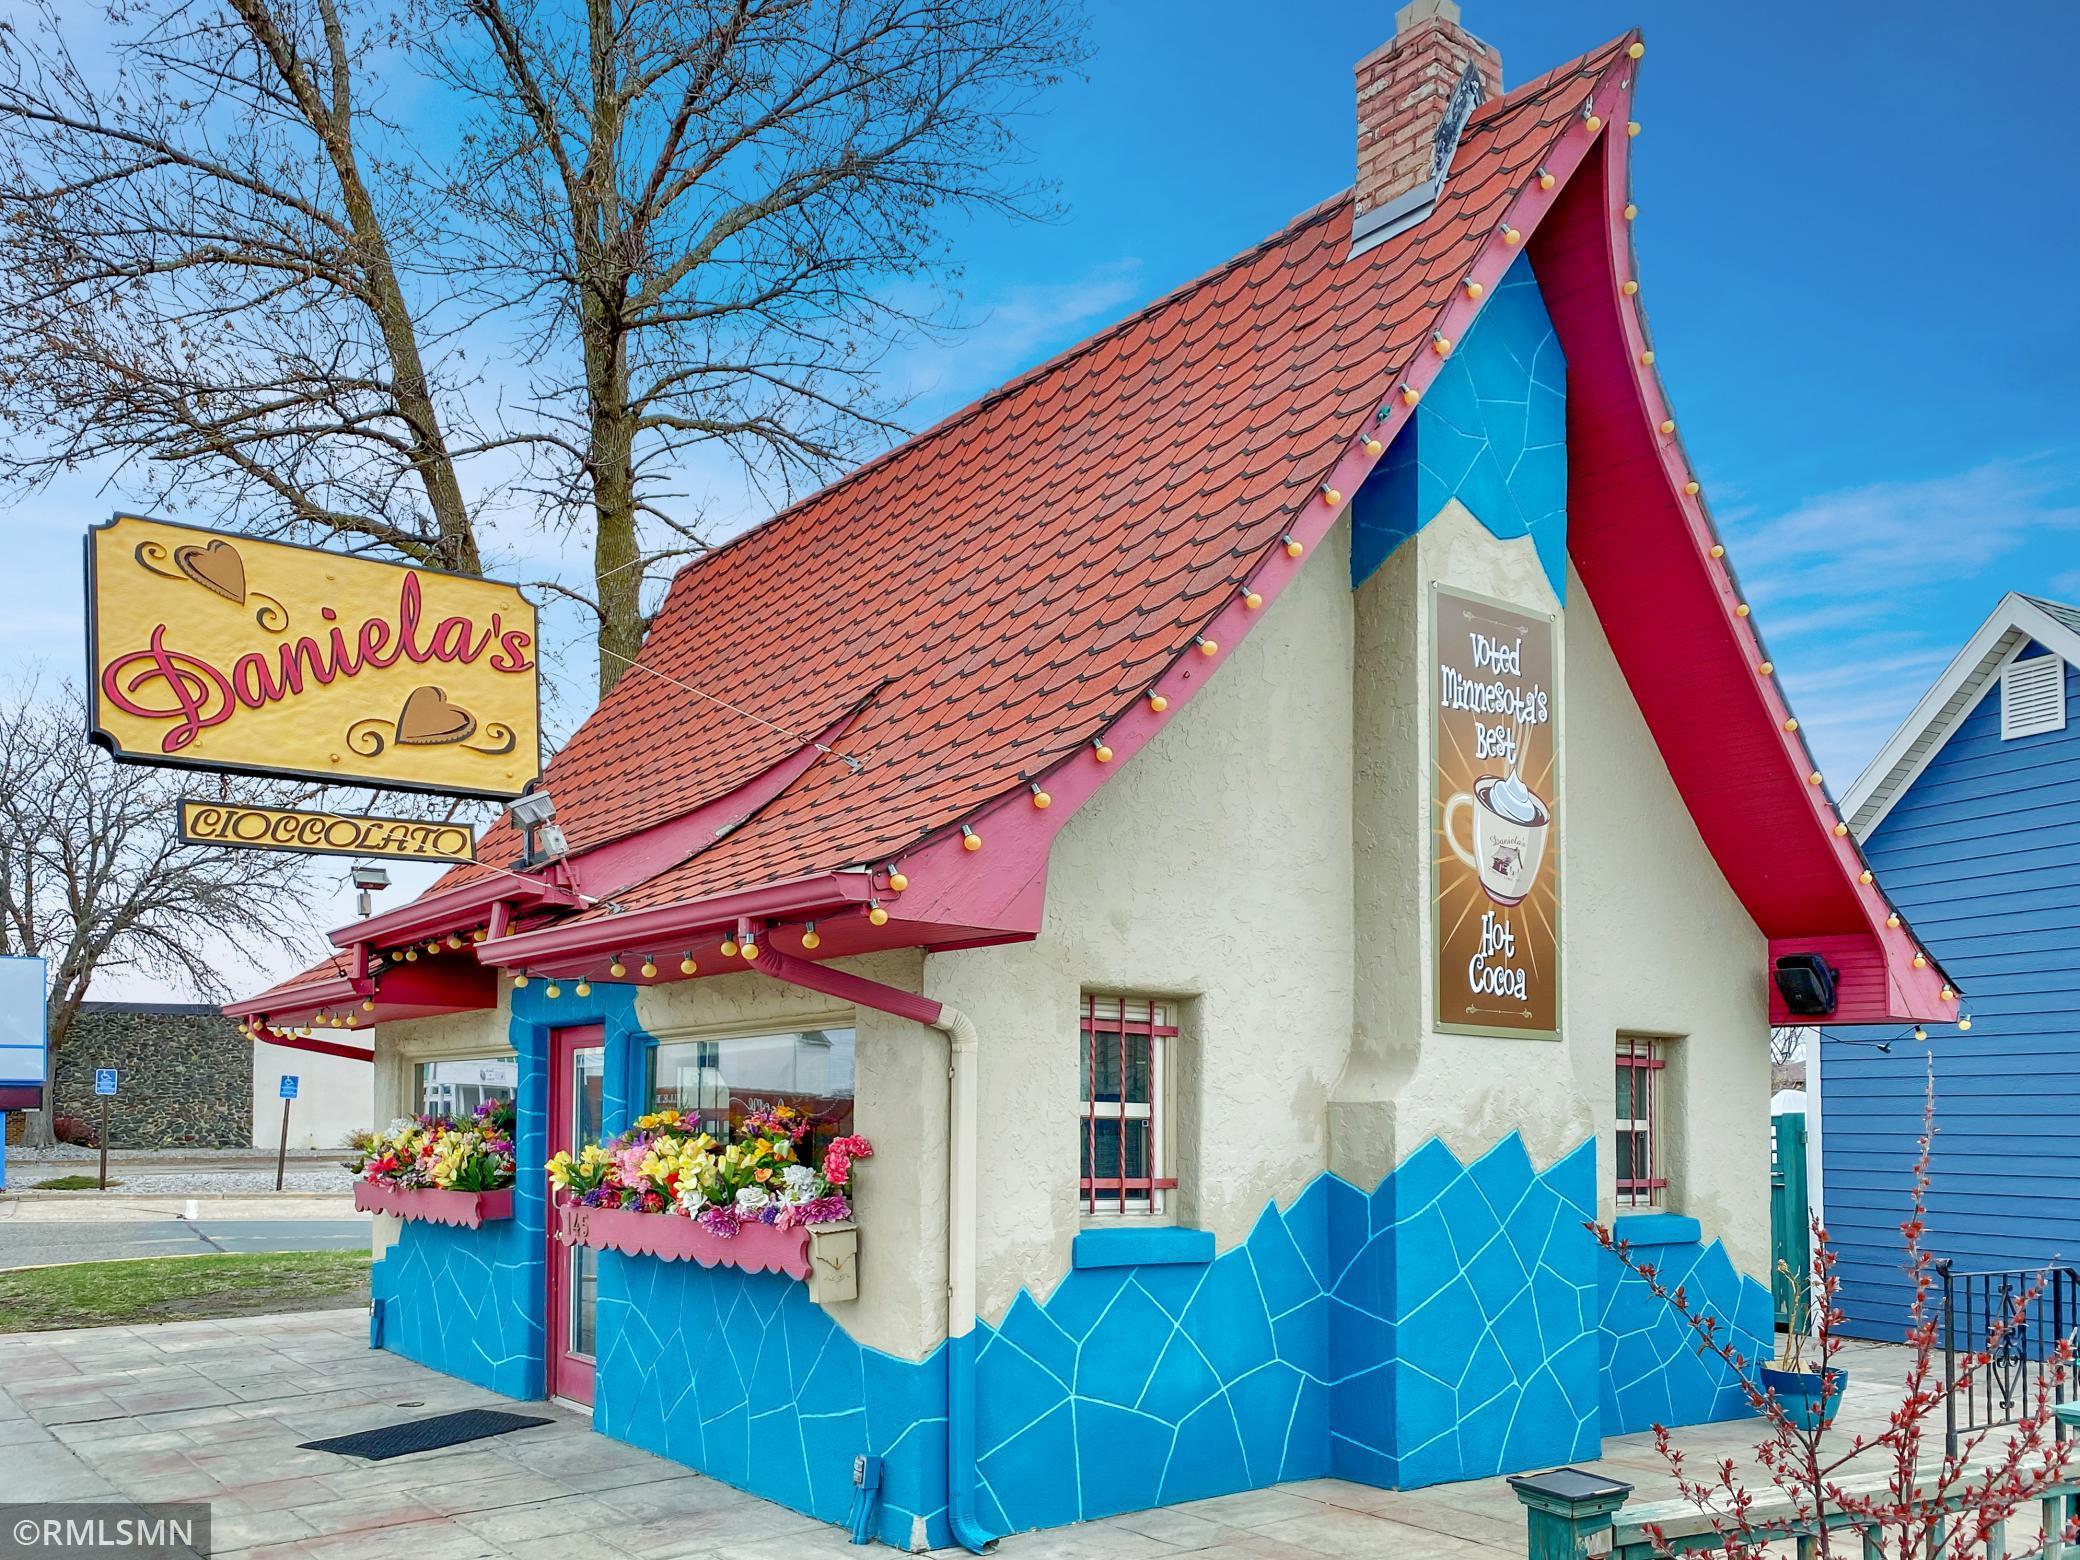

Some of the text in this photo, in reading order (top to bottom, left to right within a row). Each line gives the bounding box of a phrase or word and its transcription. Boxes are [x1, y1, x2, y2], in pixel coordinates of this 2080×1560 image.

[101, 569, 535, 753] Daniela's
[1470, 633, 1522, 676] Voted
[1441, 664, 1548, 725] Minnesota's
[1475, 721, 1517, 765] Best
[189, 808, 468, 856] CIOCCOLATO
[1481, 910, 1515, 958] Hot
[1468, 953, 1528, 1001] Cocoa
[565, 1210, 590, 1238] 145
